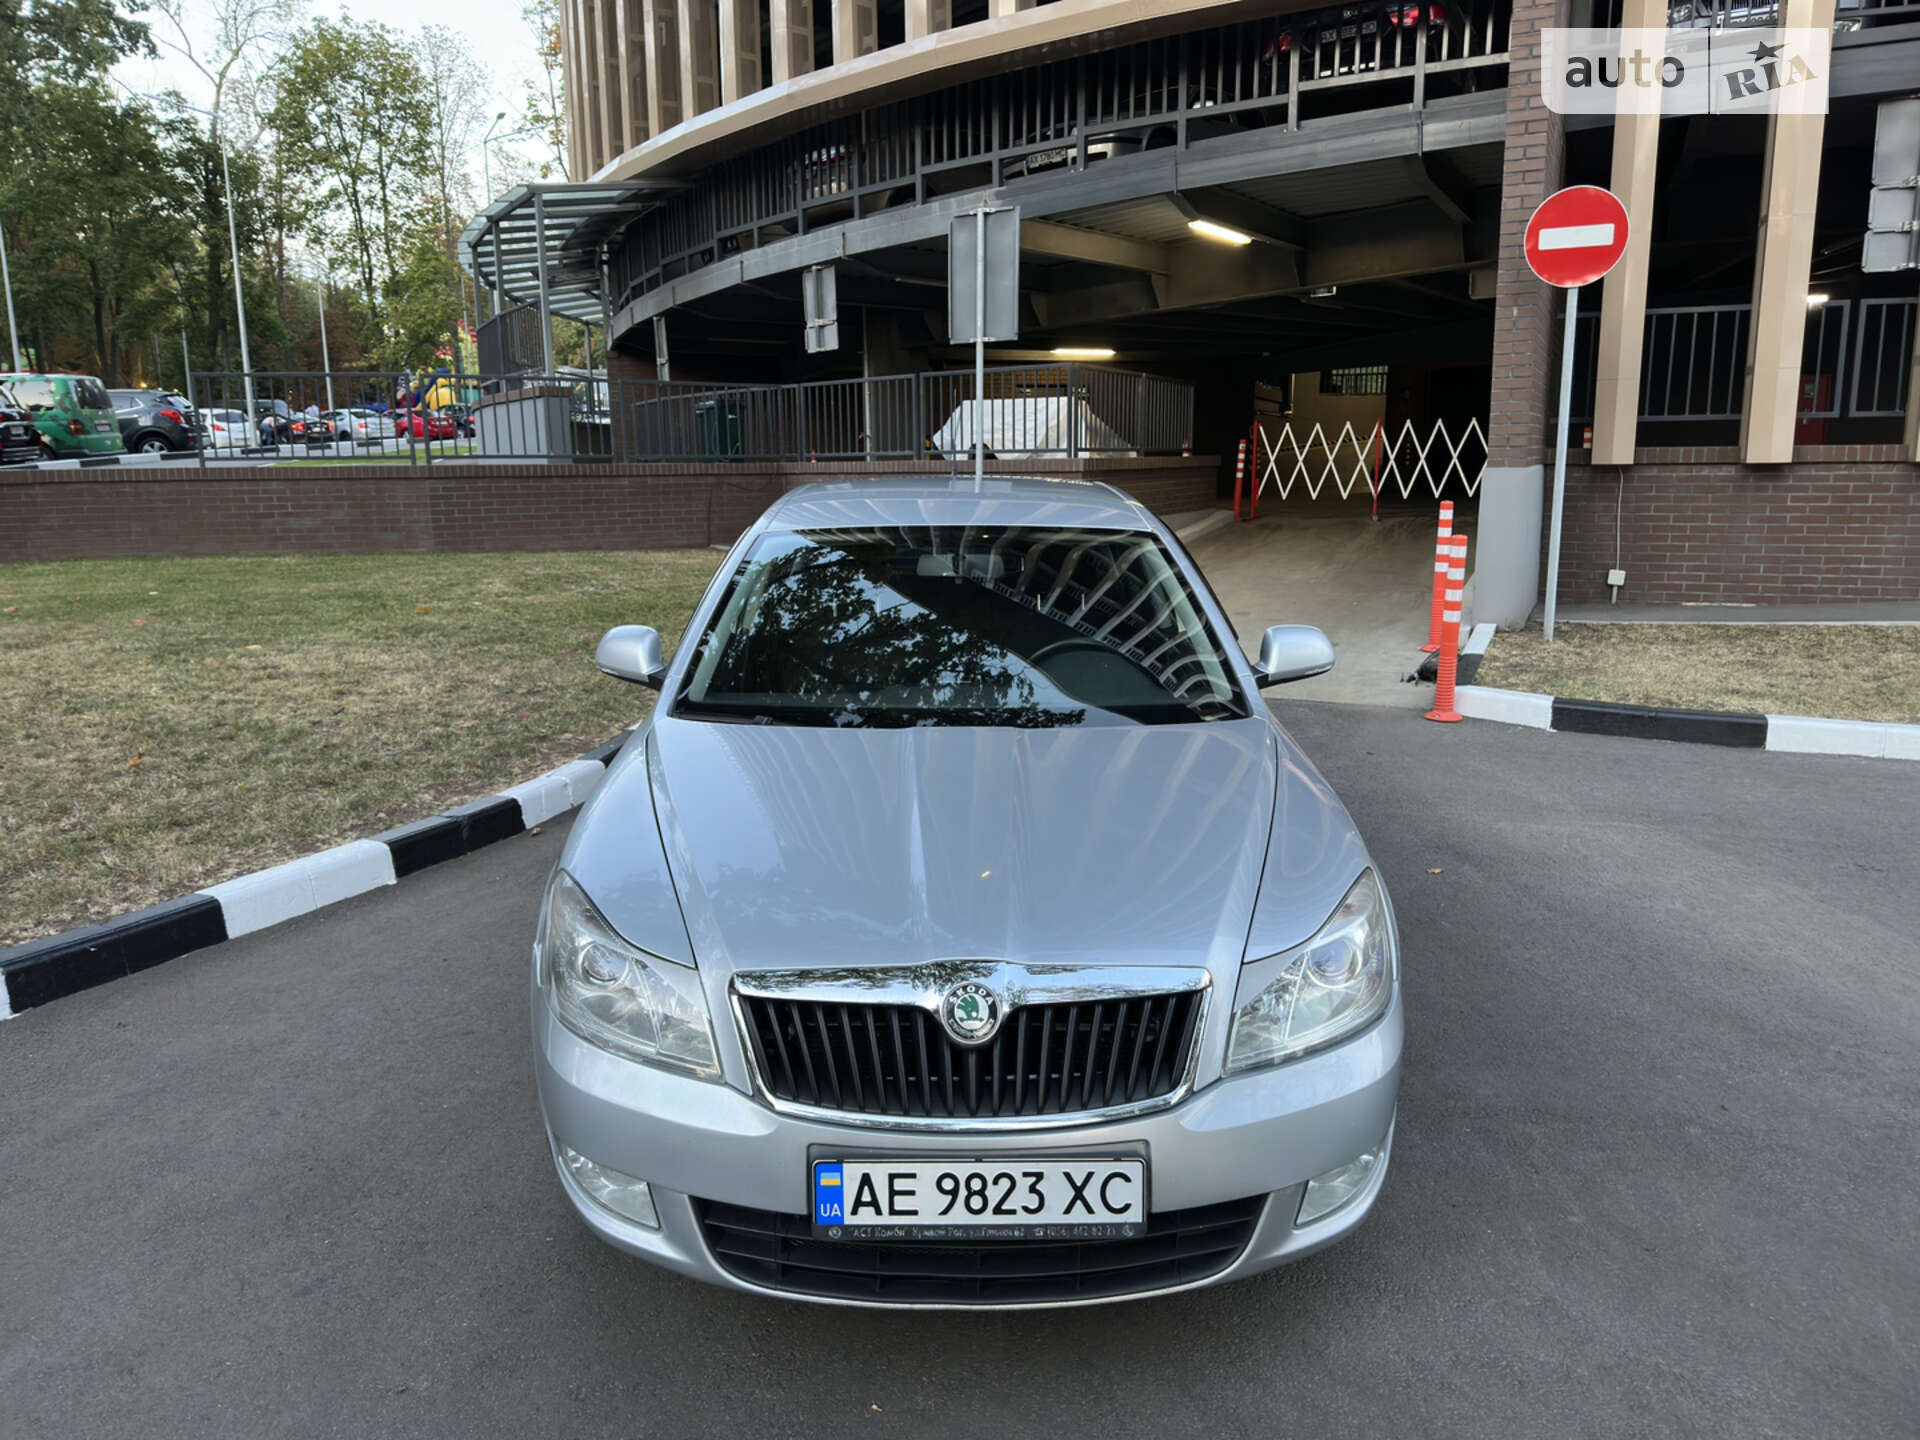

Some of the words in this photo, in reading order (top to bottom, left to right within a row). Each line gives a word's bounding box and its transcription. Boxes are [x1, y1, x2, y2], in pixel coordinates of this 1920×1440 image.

[949, 985, 993, 1005] SKODA
[850, 1172, 919, 1216] AE
[935, 1172, 1046, 1216] 9823
[1062, 1171, 1133, 1215] XC
[820, 1203, 841, 1217] UA
